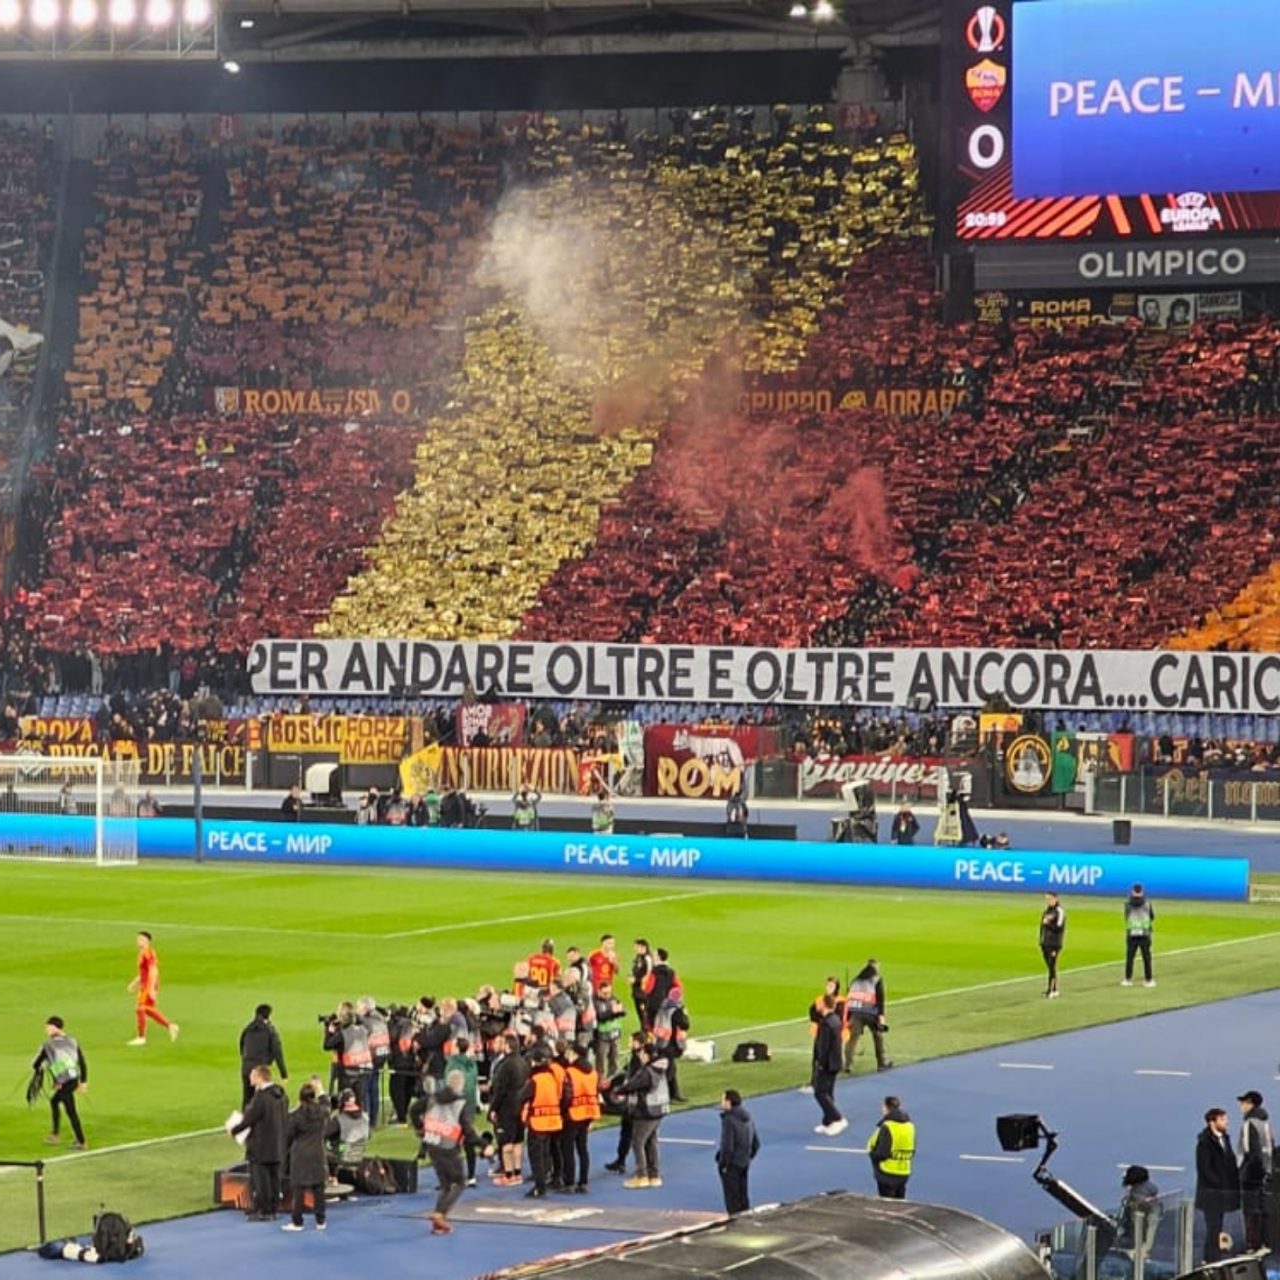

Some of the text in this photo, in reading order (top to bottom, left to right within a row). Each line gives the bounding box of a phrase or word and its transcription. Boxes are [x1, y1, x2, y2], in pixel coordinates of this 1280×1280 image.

[1049, 76, 1185, 116] PEACE
[969, 125, 1004, 168] 0
[1160, 206, 1221, 224] EUROPA
[1078, 248, 1246, 278] OLIMPICO
[1030, 298, 1091, 315] ROMA
[246, 641, 329, 691] PER
[339, 641, 535, 694] ANDARE
[547, 645, 699, 697] OLTRE
[708, 649, 734, 697] E
[746, 650, 896, 702] OLTRE
[148, 743, 176, 776] DE
[208, 833, 267, 852] PEACE
[564, 844, 628, 865] PEACE
[955, 860, 1025, 884] PEACE
